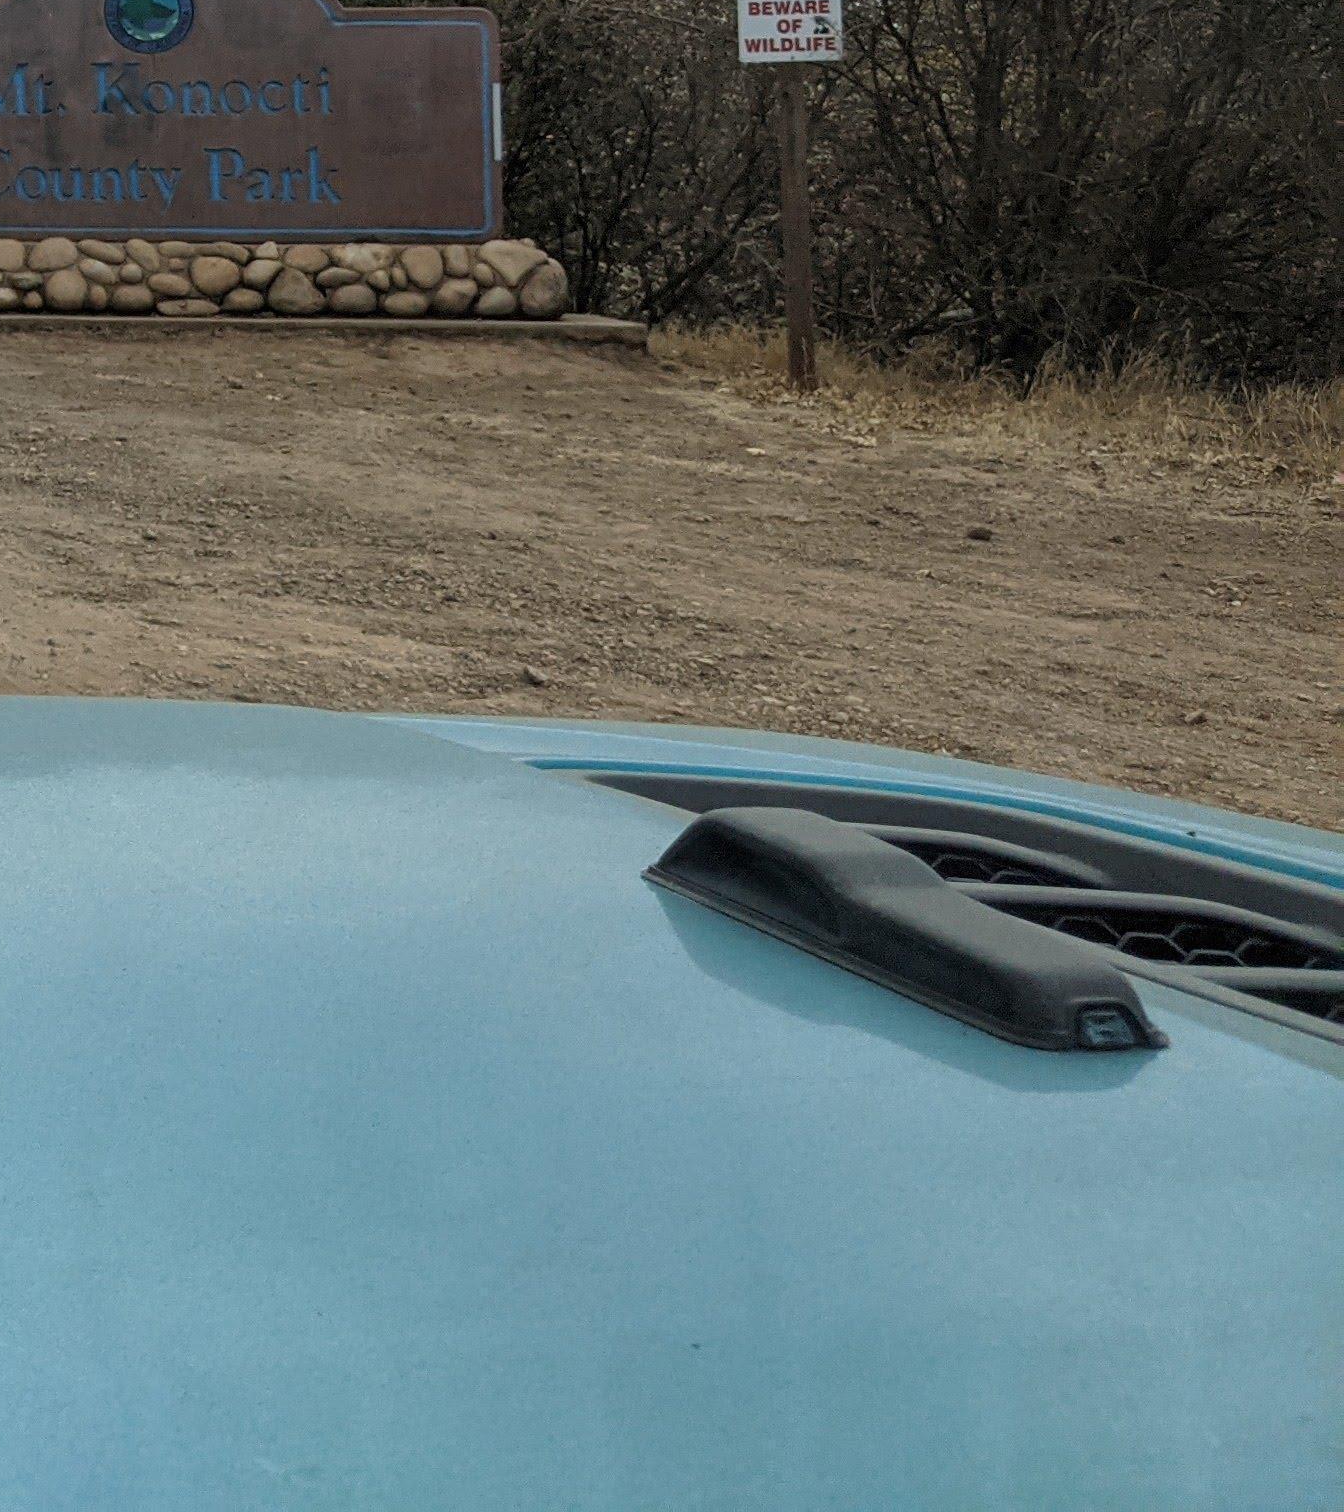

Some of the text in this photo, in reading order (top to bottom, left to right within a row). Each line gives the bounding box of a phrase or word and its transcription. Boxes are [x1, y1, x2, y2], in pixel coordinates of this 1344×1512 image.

[748, 0, 830, 16] BEWARE
[776, 19, 802, 34] OF
[744, 36, 837, 53] WILDLIFE
[89, 61, 334, 116] Konocti
[202, 145, 343, 205] Park
